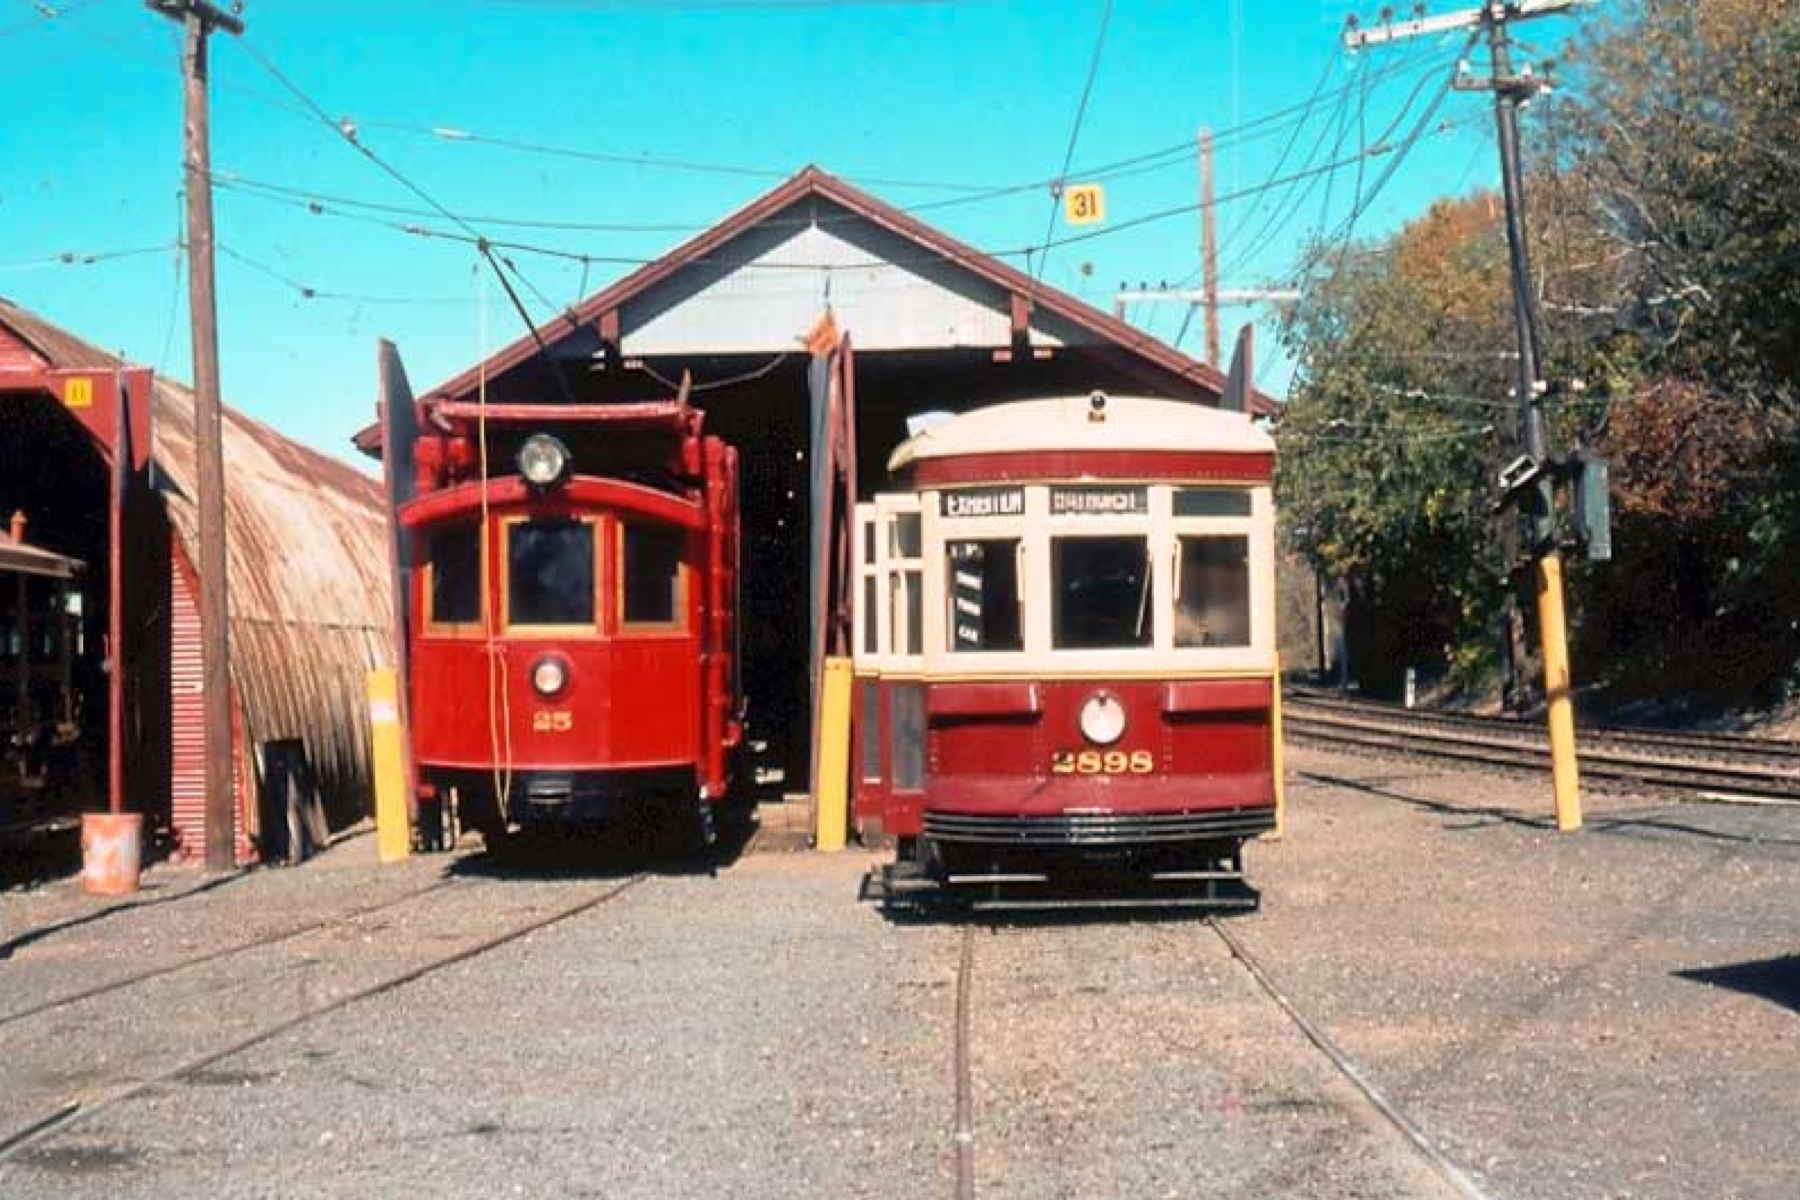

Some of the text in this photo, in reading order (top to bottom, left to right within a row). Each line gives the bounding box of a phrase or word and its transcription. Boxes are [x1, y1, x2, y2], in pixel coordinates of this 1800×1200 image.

[1073, 191, 1097, 219] 31
[532, 711, 573, 733] 25
[1051, 751, 1154, 774] 2898
